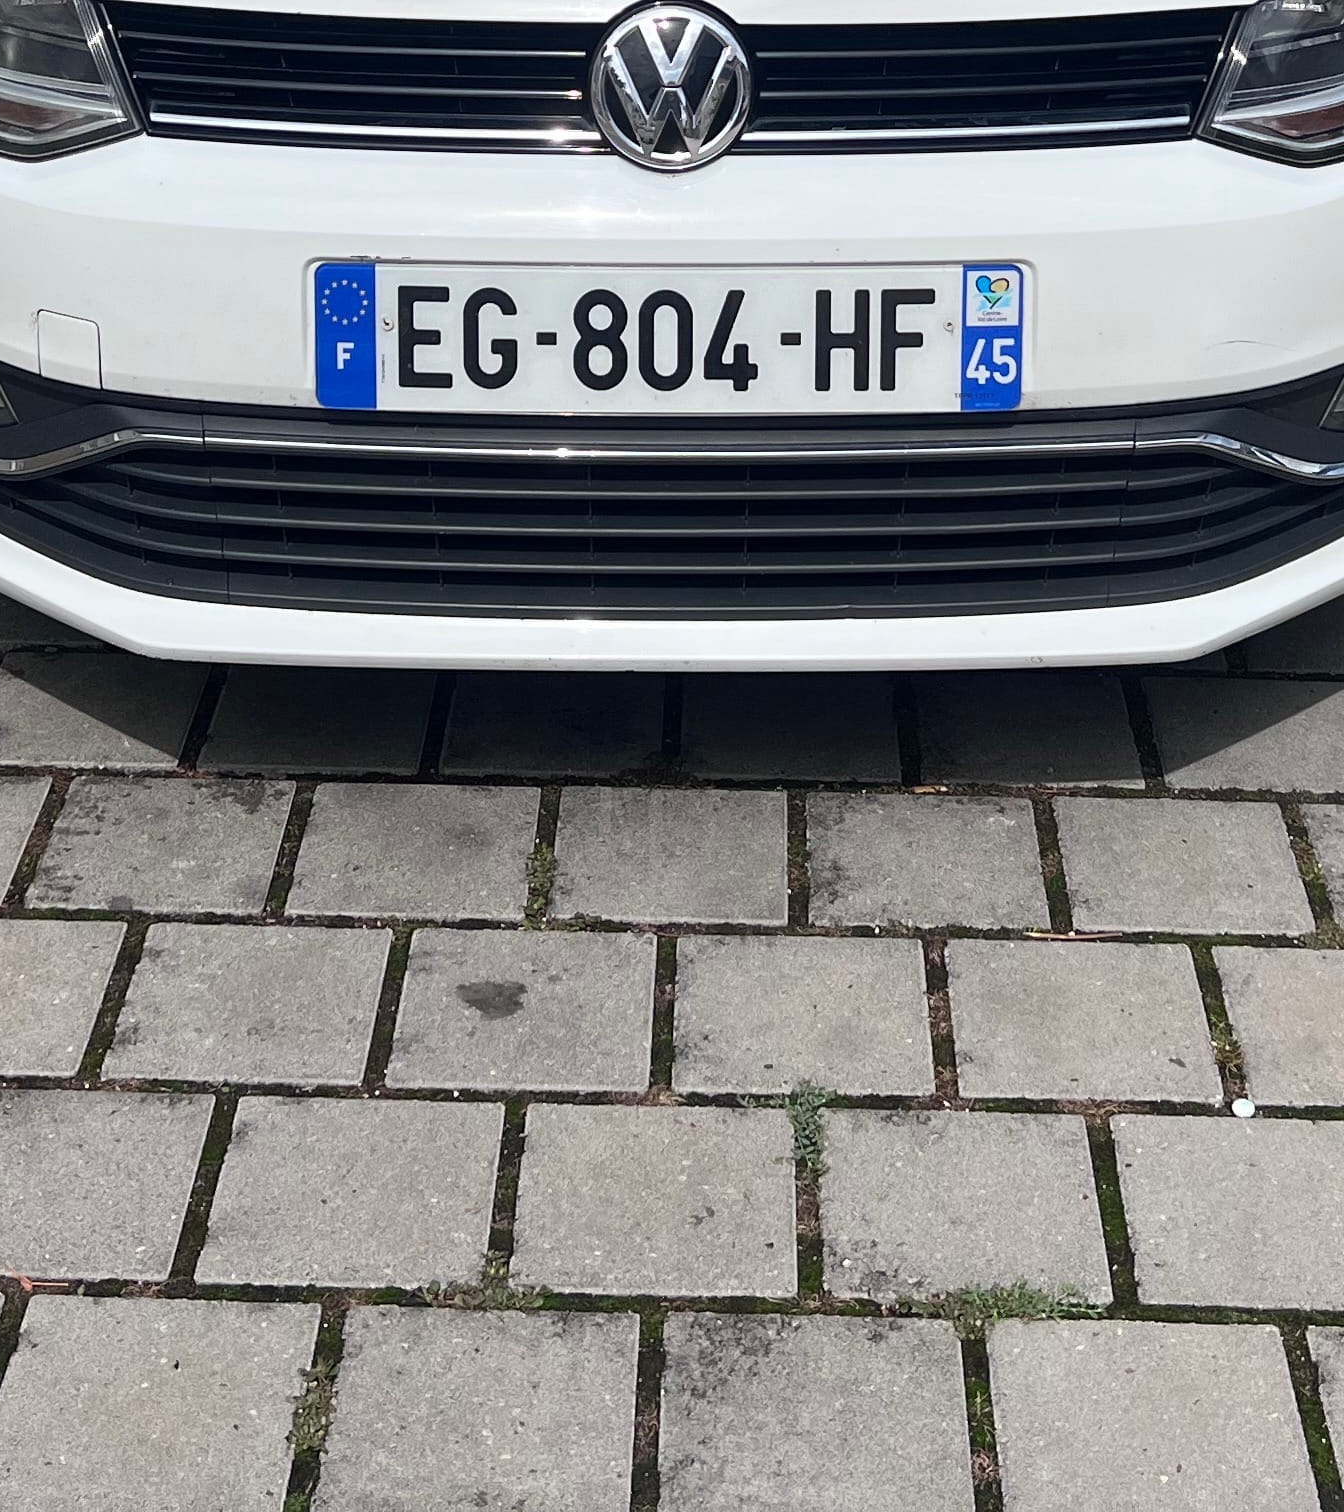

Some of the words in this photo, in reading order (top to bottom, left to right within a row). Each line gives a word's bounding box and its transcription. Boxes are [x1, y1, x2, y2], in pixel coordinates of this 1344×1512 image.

[337, 341, 355, 370] F
[396, 285, 936, 393] EG-804-HF
[965, 337, 1017, 385] 45
